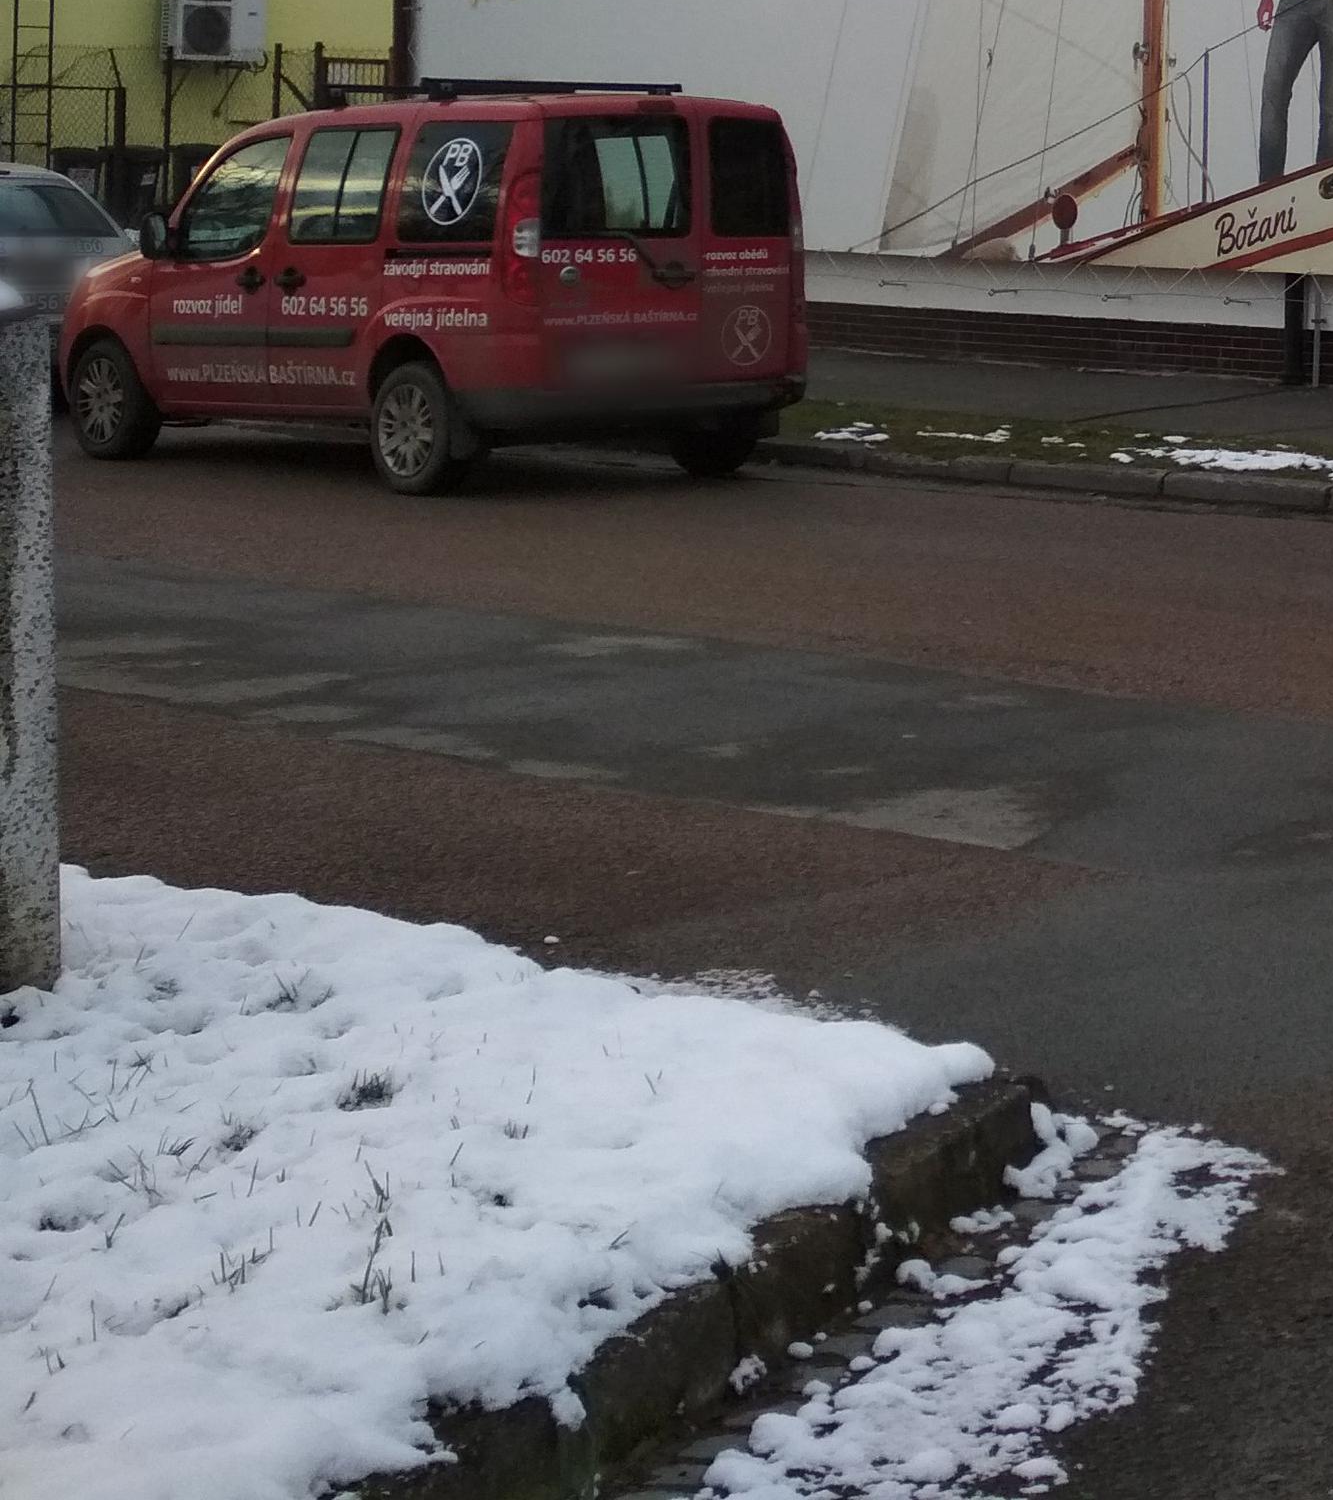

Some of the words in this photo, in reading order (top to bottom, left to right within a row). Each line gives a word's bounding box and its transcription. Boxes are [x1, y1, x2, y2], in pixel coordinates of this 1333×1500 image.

[443, 143, 474, 168] PB
[1214, 196, 1297, 257] Božani
[541, 250, 570, 264] 602
[574, 249, 593, 263] 64
[597, 249, 615, 263] 56
[619, 248, 637, 262] 56
[173, 299, 211, 315] rozvoz
[281, 296, 306, 316] 602
[309, 296, 326, 316] 64
[329, 297, 347, 317] 56
[350, 298, 369, 317] 56
